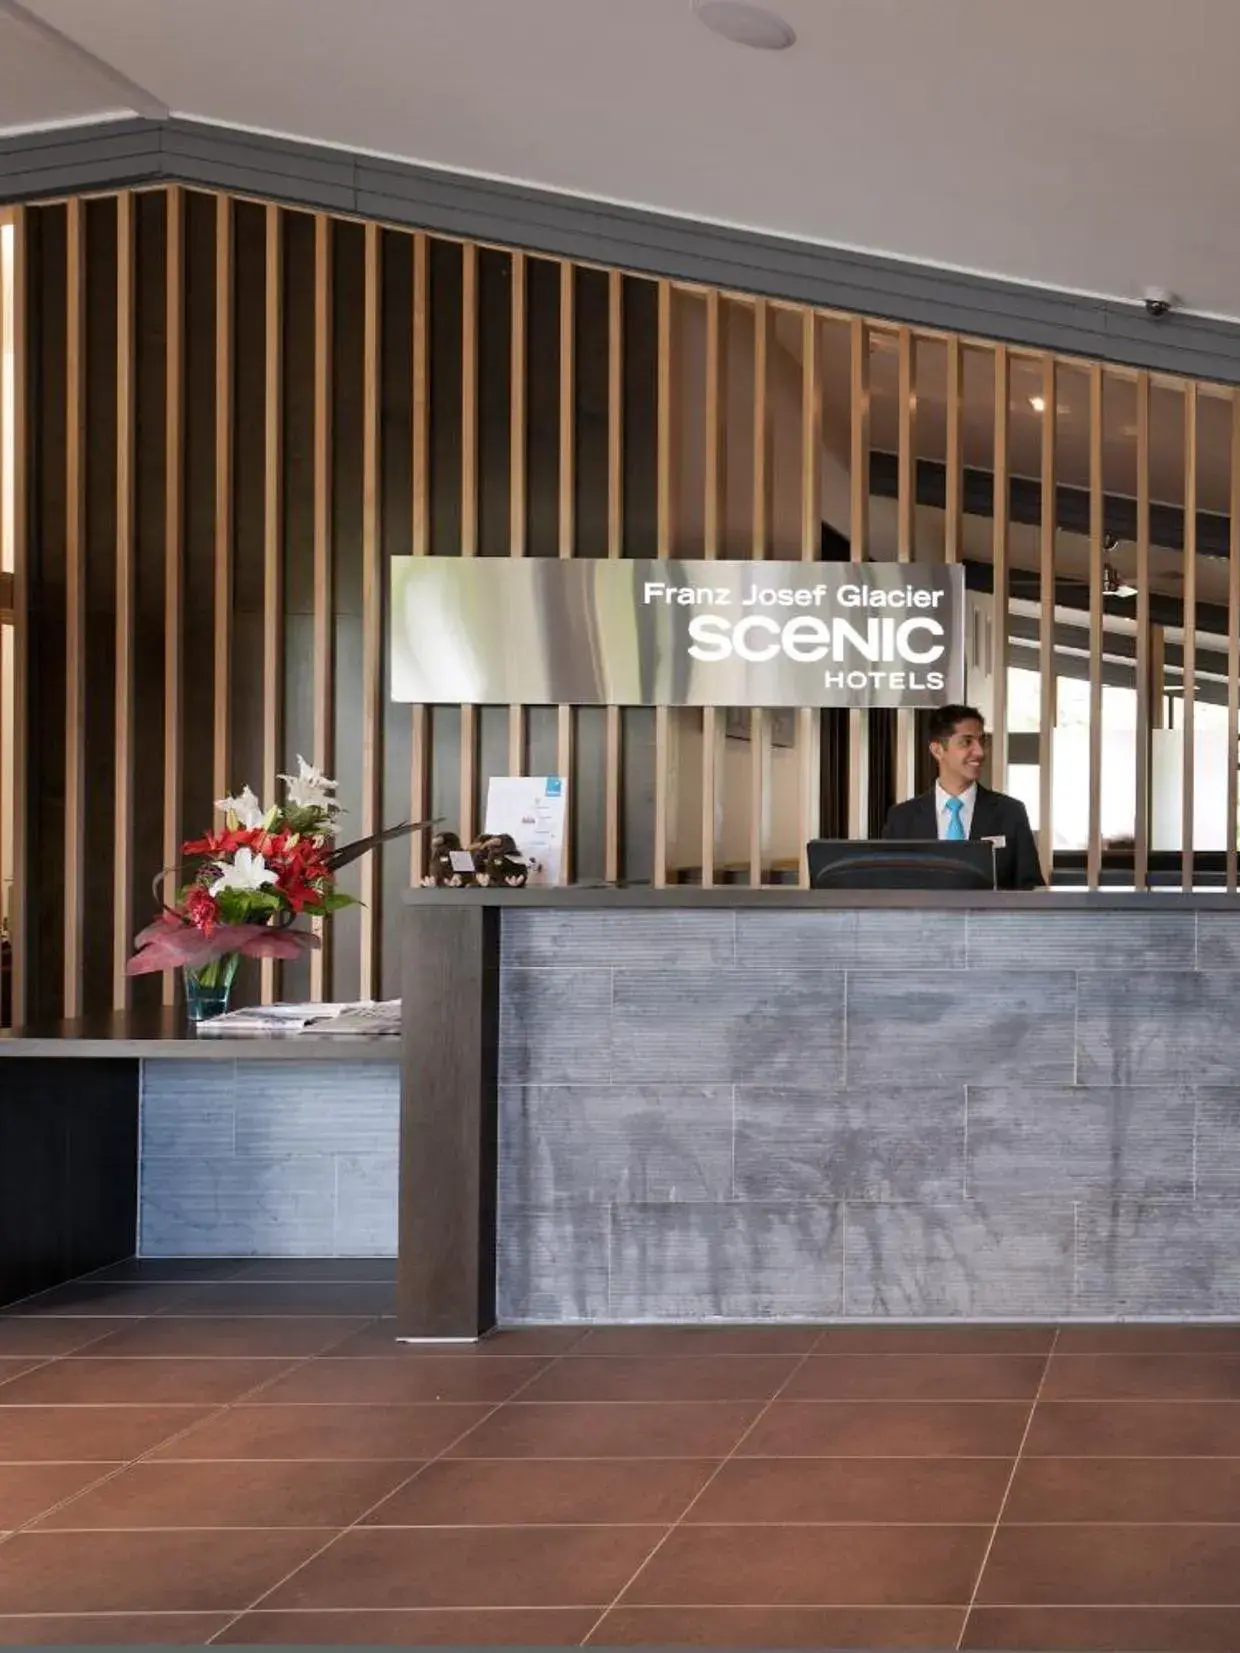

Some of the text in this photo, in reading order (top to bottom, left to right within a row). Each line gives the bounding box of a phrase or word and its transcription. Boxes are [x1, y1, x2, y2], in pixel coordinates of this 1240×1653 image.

[643, 582, 945, 608] Franz Josef Glacier
[824, 671, 945, 690] HOTELS
